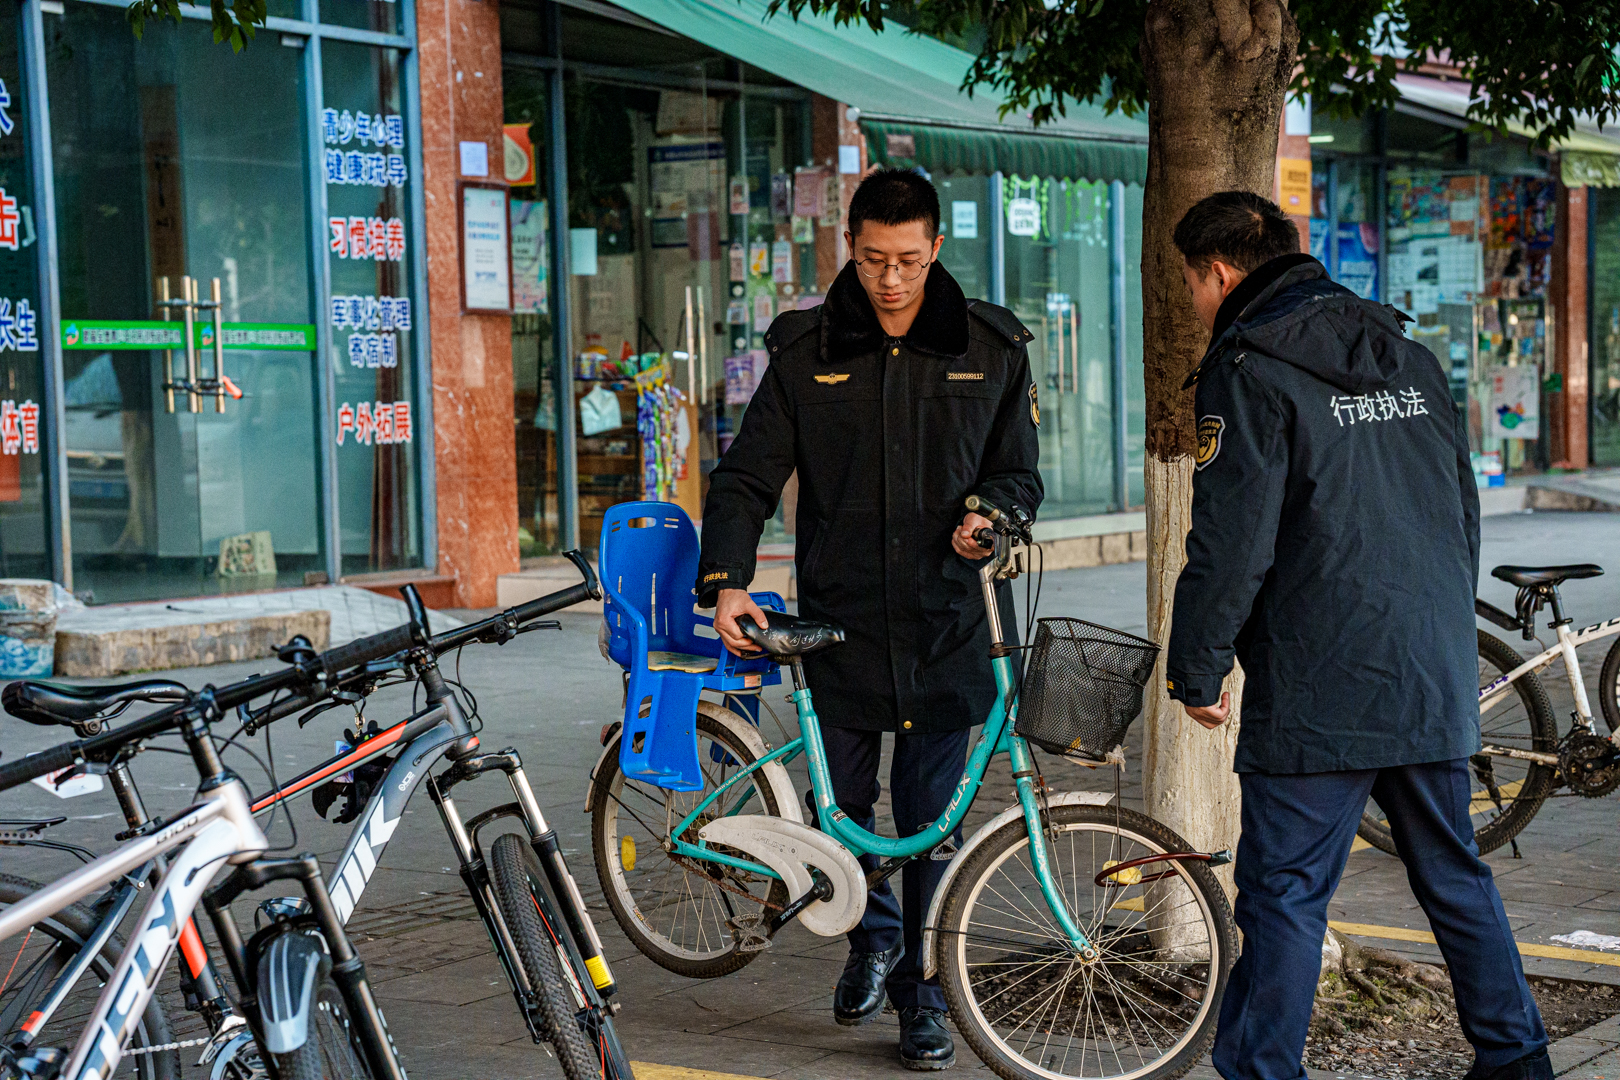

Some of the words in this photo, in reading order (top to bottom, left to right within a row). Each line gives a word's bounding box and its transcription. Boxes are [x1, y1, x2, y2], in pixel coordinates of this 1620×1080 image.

[321, 107, 404, 148] 青少年心理
[325, 148, 407, 188] 健康疏导
[329, 215, 406, 261] 习惯培养
[331, 294, 411, 331] 军事化管理
[348, 332, 397, 368] 寄宿制
[336, 400, 413, 446] 户外拓展
[1330, 386, 1429, 427] 行政执法
[938, 773, 971, 833] LAUX
